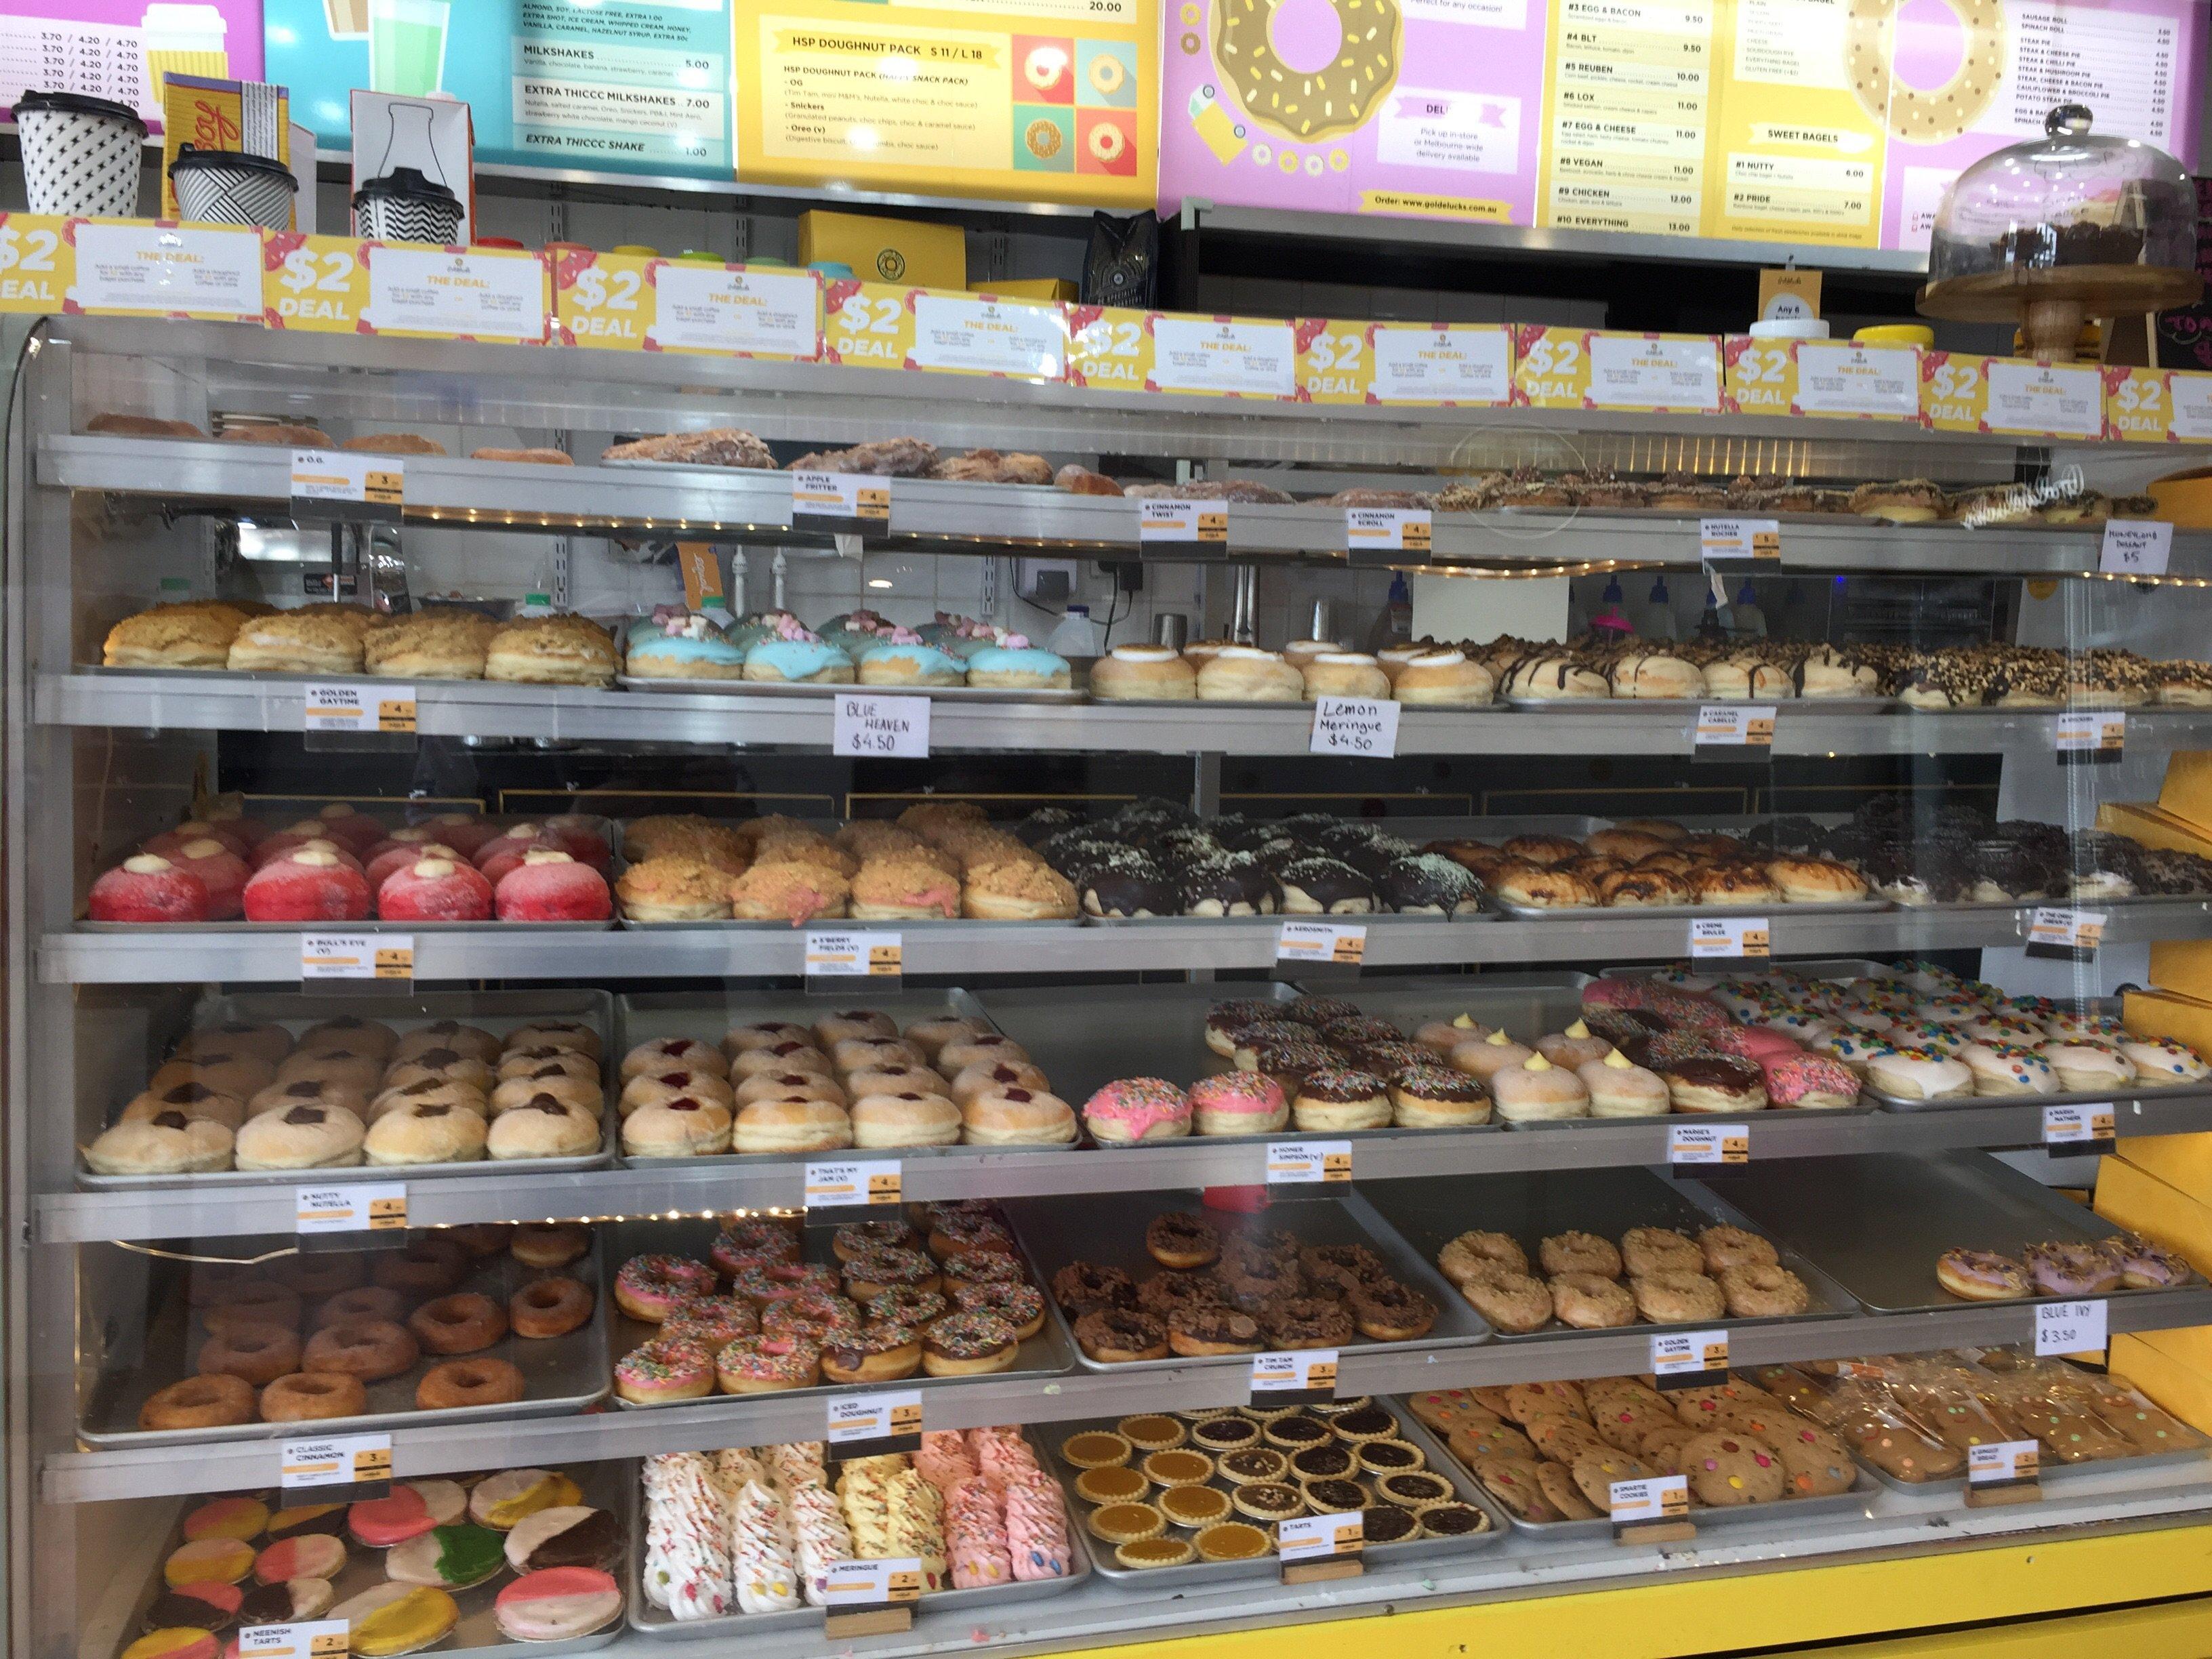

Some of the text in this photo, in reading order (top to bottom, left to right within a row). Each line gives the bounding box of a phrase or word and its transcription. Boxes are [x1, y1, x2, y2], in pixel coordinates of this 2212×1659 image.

[1089, 2, 1122, 12] 20.00
[1452, 1, 1502, 12] any occasion!
[1582, 5, 1599, 13] EGG
[1610, 7, 1641, 17] BACON
[2022, 14, 2051, 22] SAUSAGE
[2022, 24, 2048, 32] SPINACH
[41, 33, 137, 48] 3.70 4.20 4.70
[1581, 34, 1597, 43] BLT
[42, 45, 138, 60] 3.70 4.20 4.70
[793, 37, 982, 60] HSP DOUGHNUT PACK S 11 L 18
[44, 57, 138, 72] 3.70 4.20 4.70
[524, 45, 594, 60] MILKSHAKES
[686, 60, 709, 69] 5.00
[43, 69, 138, 84] 3.70 4.20 4.70
[803, 67, 851, 77] DOUGHNUT
[854, 70, 877, 79] PACK
[913, 75, 940, 83] SNACK
[943, 77, 968, 85] PACK)
[1579, 64, 1613, 74] REUBEN
[1677, 73, 1700, 82] 10.00
[44, 81, 139, 96] 3.70 4.20 4.70
[525, 85, 710, 109] EXTRA THICCC MILKSHAKES 7.00
[1577, 94, 1595, 102] LOX
[1677, 102, 1698, 110] 11.00
[791, 102, 824, 111] Snickers
[792, 125, 811, 133] Oreo
[1421, 127, 1448, 138] Pick up
[1576, 122, 1593, 131] EGG
[1603, 124, 1636, 134] CHEESE
[1676, 129, 1696, 140] 11.00
[1768, 129, 1838, 143] SWEET BAGELS
[526, 134, 561, 145] EXTRA
[567, 137, 605, 148] THICCC
[609, 140, 644, 152] SHAKE
[1416, 150, 1480, 162] delivery available
[1573, 159, 1603, 167] VEGAN
[1674, 166, 1694, 175] 11.00
[1747, 161, 1774, 171] NUTTY
[1572, 188, 1610, 198] CHICKEN
[1375, 196, 1497, 214] Order: www.goldelucks.com.au
[1746, 194, 1771, 203] PRIDE
[1844, 201, 1862, 210] 7.00
[1575, 216, 1629, 228] EVERYTHING
[279, 247, 354, 294] $2
[427, 274, 451, 285] THE
[573, 265, 640, 312] $2
[709, 293, 731, 303] THE
[279, 298, 350, 321] DEAL
[839, 293, 901, 335] $2
[1778, 306, 1795, 314] Any
[572, 316, 636, 338] DEAL
[964, 321, 983, 330] THE
[1083, 319, 1141, 359] $2
[1200, 342, 1218, 350] THE
[838, 337, 898, 359] DEAL
[1307, 332, 1362, 372] $2
[1526, 339, 1579, 377] $2
[1082, 362, 1139, 381] DEAL
[1737, 348, 1786, 385] $2
[1307, 377, 1360, 394] DEAL
[1526, 380, 1577, 398] DEAL
[1932, 363, 1979, 401] $2
[1737, 388, 1785, 405] DEAL
[2118, 377, 2160, 413] $2
[1931, 405, 1974, 421] DEAL
[2118, 416, 2160, 431] DEAL
[320, 689, 357, 697] GOLDEN
[846, 701, 878, 718] BLUE
[1324, 701, 1377, 717] Lemon
[865, 718, 910, 733] HEAVEN
[1320, 719, 1382, 735] Meringue
[852, 733, 895, 751] $4.50
[840, 1408, 882, 1418] DOUGHNUT
[295, 1444, 333, 1453] CLASSIC
[295, 1452, 344, 1461] CINNAMON
[253, 1629, 291, 1637] NEENISH
